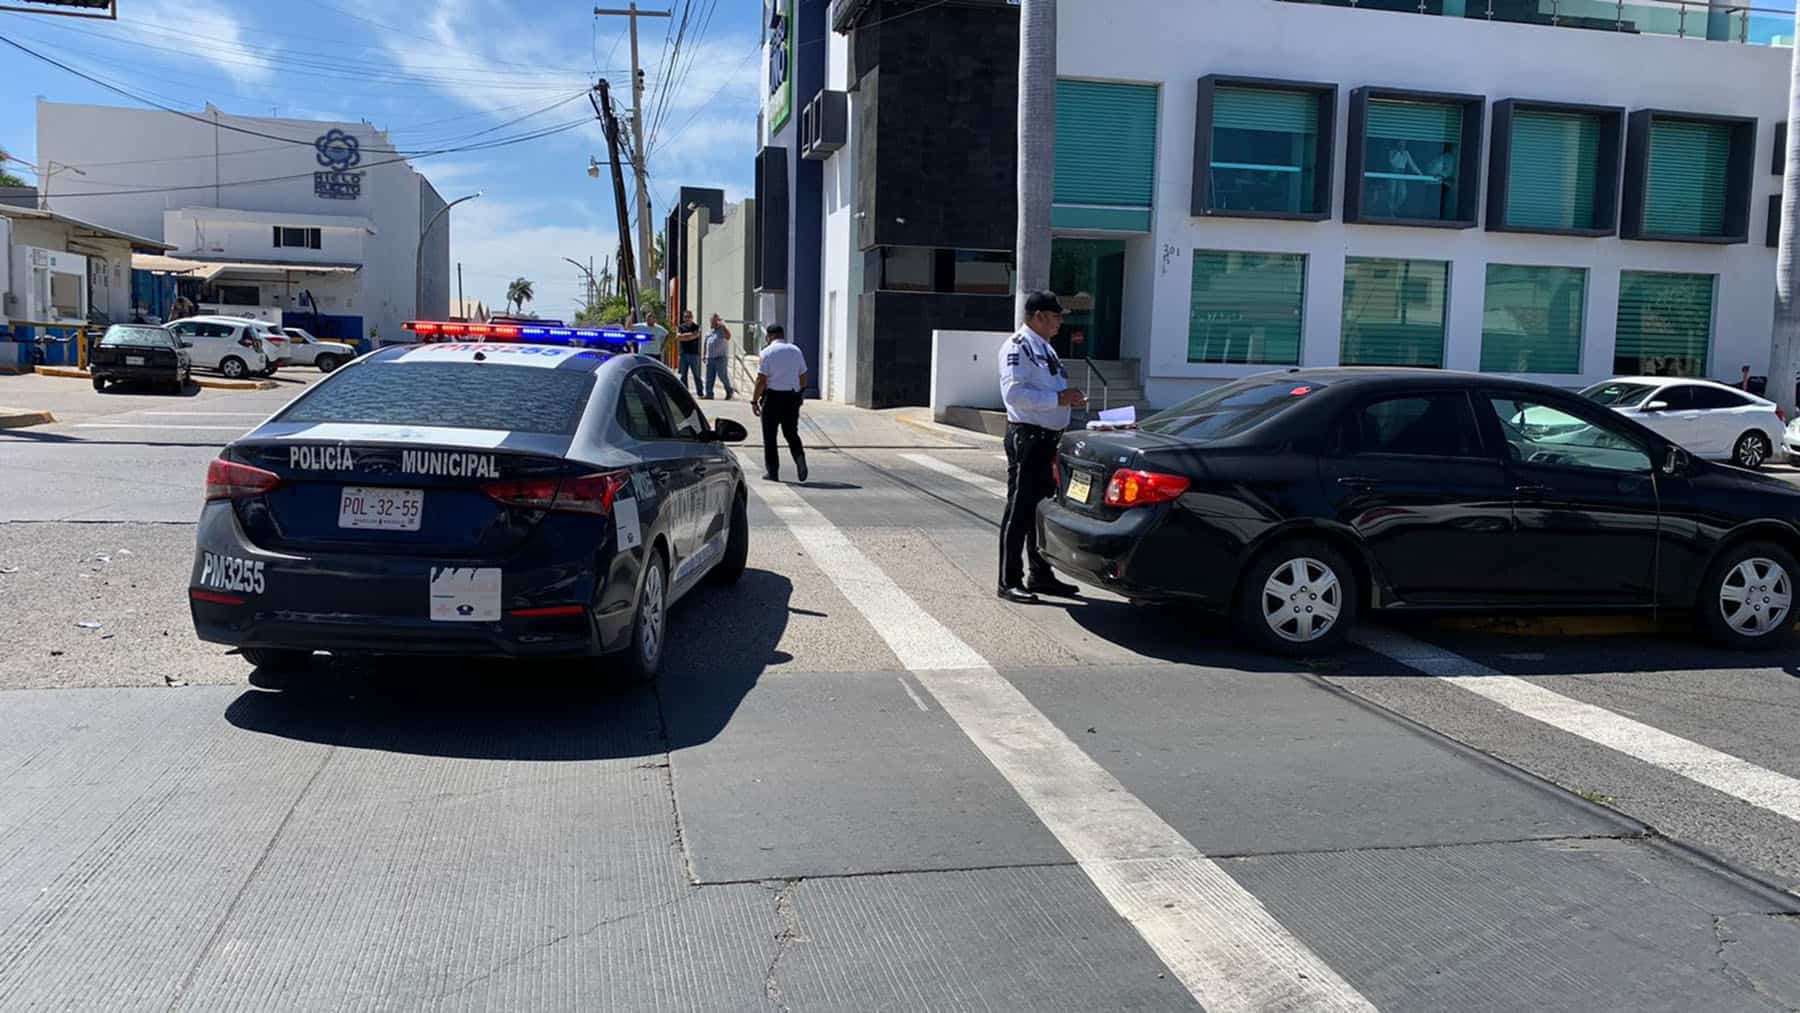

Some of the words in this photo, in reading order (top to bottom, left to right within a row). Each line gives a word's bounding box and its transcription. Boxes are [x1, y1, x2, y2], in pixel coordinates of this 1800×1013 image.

[290, 442, 353, 471] POLICÍA
[402, 450, 499, 478] MUNICIPAL
[343, 496, 419, 517] POL-32-55
[200, 552, 265, 594] PM3255
